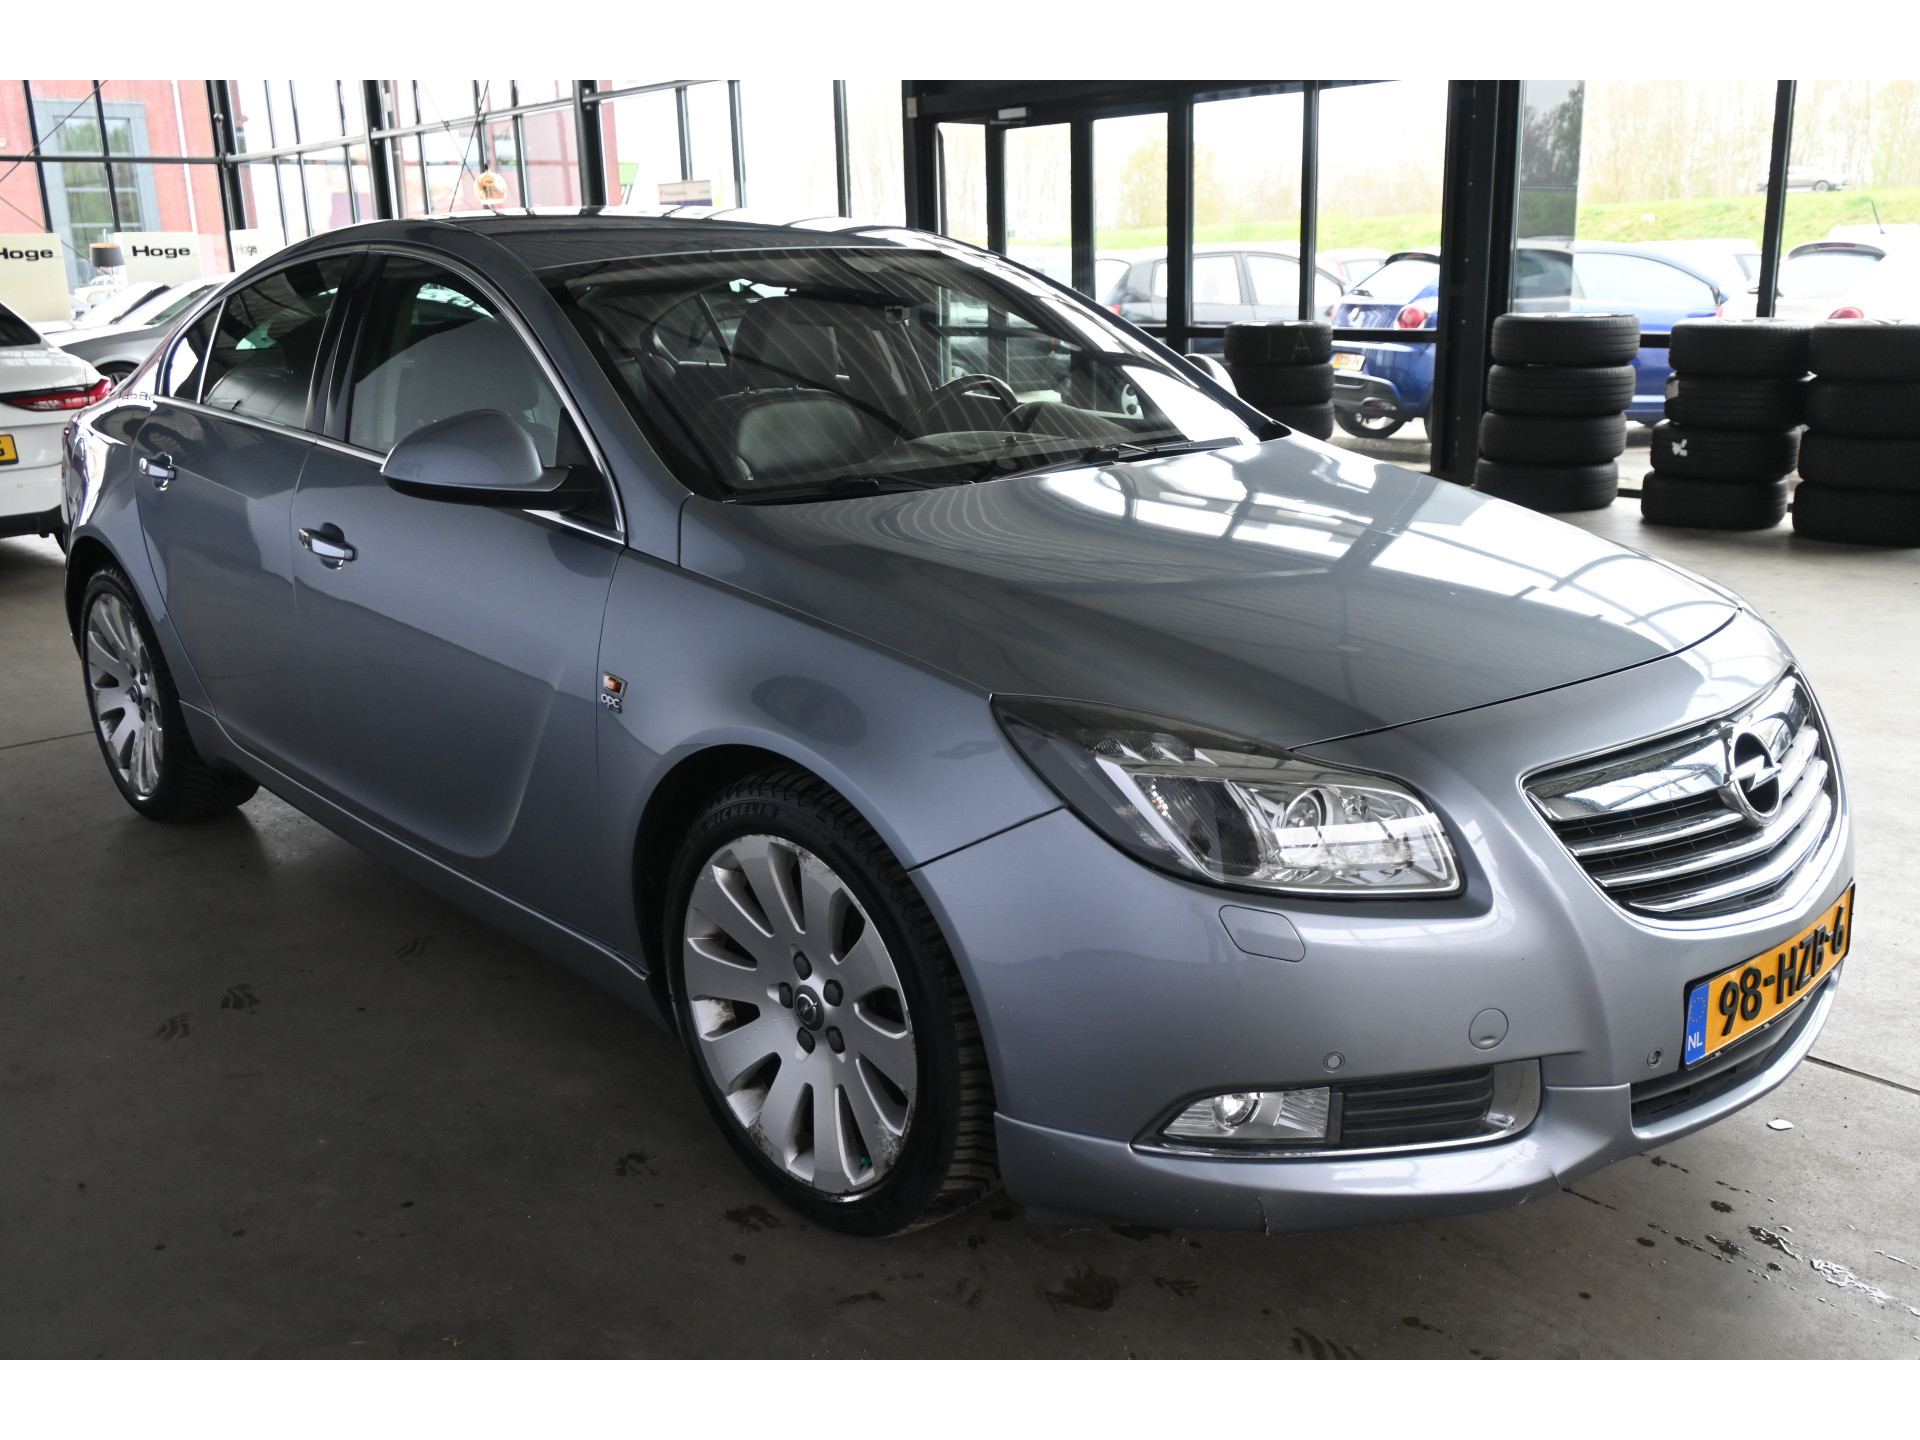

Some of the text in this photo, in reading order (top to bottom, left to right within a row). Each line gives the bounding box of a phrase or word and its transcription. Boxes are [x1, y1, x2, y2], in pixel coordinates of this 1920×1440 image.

[131, 245, 191, 259] Hoge
[706, 802, 777, 829] MICHELIN
[1719, 904, 1845, 1036] 98-HZB-6
[1687, 1031, 1704, 1051] NL
